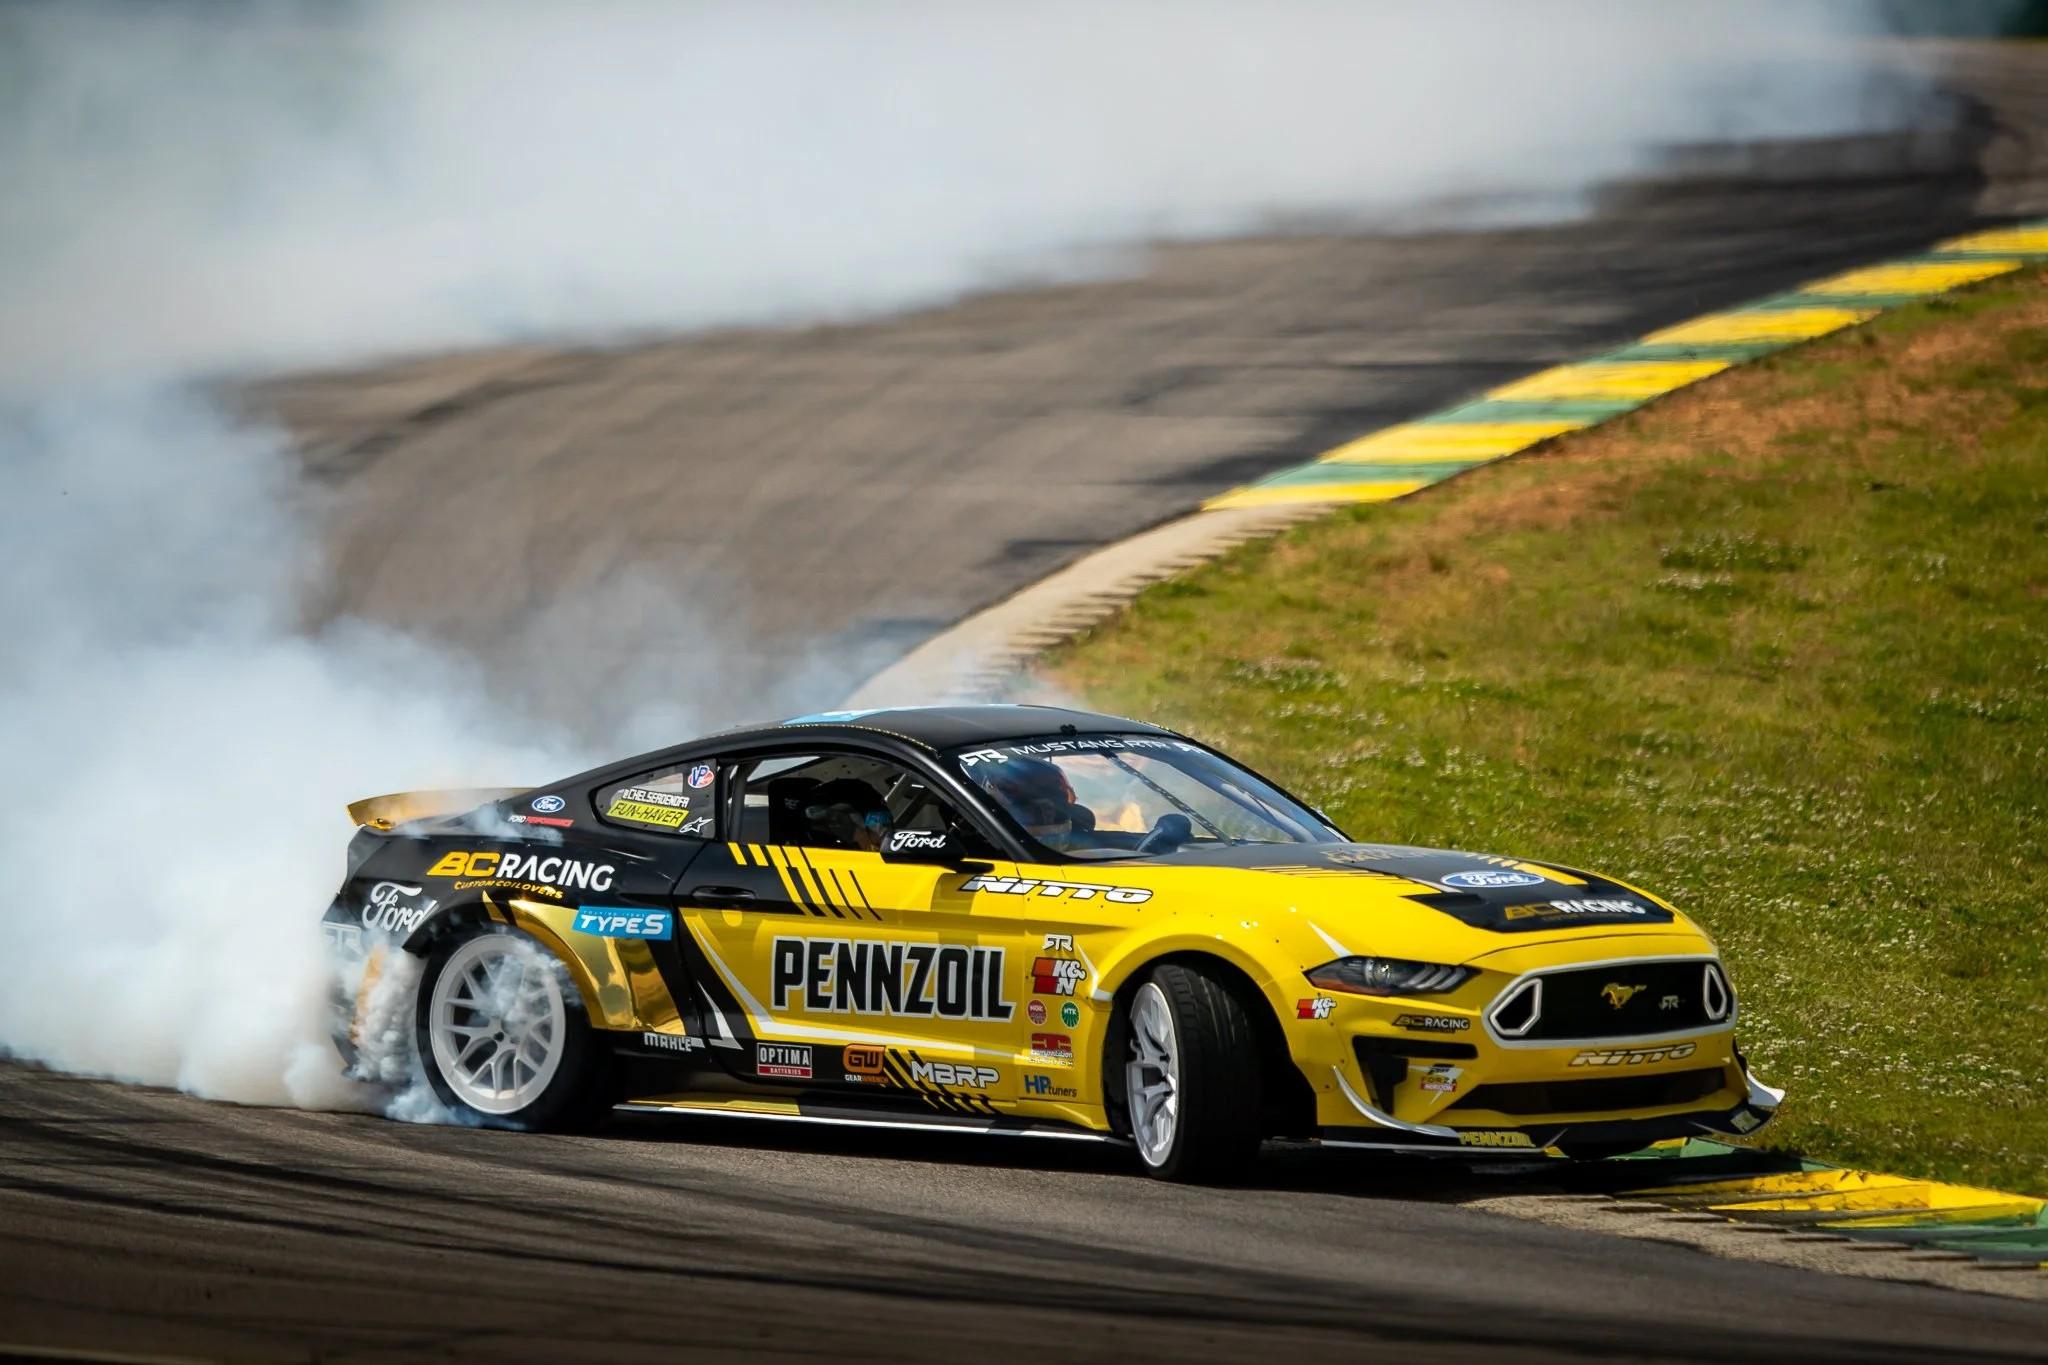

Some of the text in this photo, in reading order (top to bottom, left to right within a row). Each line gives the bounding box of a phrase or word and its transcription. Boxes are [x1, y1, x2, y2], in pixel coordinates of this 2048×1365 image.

[1011, 740, 1124, 755] MUSTANG
[610, 802, 684, 824] FUN-HAVER
[890, 831, 947, 851] Ford
[454, 880, 495, 891] CUSTOM
[958, 875, 1153, 905] NITTO
[362, 882, 438, 933] Ford
[771, 935, 1016, 1022] PENNZOIL
[644, 1032, 692, 1052] MAHLE
[760, 1047, 810, 1066] OPTIMA
[1568, 1042, 1697, 1067] NITTO
[770, 1067, 802, 1076] BATTERIES
[909, 1060, 1000, 1089] MBRP
[1458, 1131, 1536, 1148] PENNZOIL
